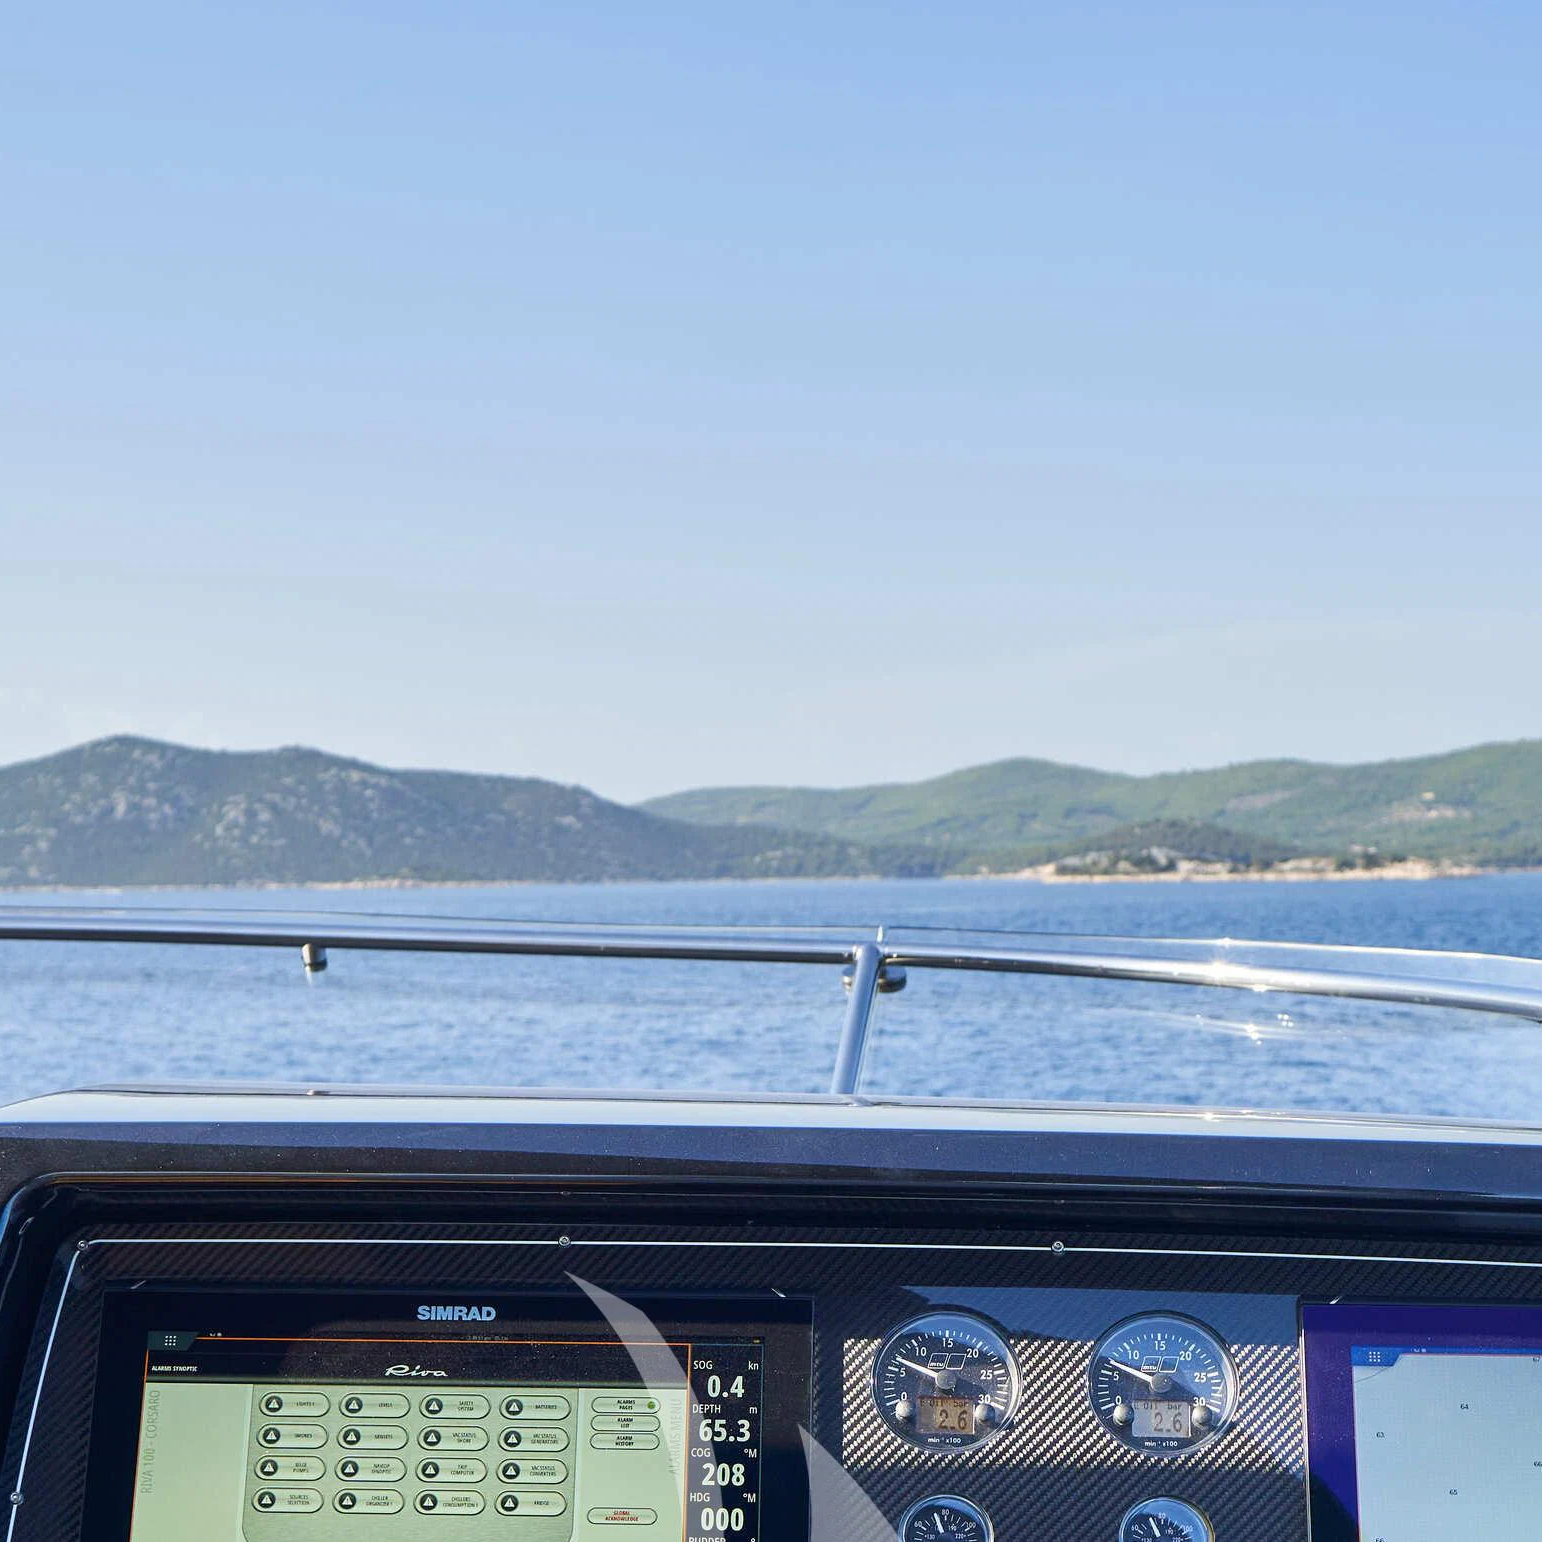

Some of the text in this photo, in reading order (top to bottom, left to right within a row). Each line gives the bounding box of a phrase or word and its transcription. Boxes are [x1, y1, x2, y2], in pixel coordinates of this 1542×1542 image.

[417, 1305, 496, 1321] SIMRAD
[942, 1338, 953, 1348] 15
[1154, 1340, 1166, 1351] 15
[915, 1347, 927, 1356] 10
[966, 1348, 979, 1358] 20
[1128, 1350, 1139, 1360] 10
[1179, 1351, 1192, 1361] 20
[693, 1360, 713, 1371] SOG
[748, 1360, 759, 1371] kn
[384, 1364, 449, 1378] Riva
[900, 1367, 906, 1377] 5
[980, 1370, 993, 1380] 25
[1113, 1371, 1119, 1381] 5
[1194, 1372, 1207, 1383] 25
[707, 1375, 745, 1398] 0.4
[901, 1392, 907, 1401] 0
[978, 1394, 991, 1404] 30
[1115, 1395, 1122, 1405] 0
[1193, 1397, 1206, 1406] 30
[692, 1404, 721, 1414] DEPTH
[749, 1406, 758, 1414] m
[145, 1390, 161, 1439] CORSARO
[939, 1409, 968, 1430] 2.6
[1153, 1412, 1182, 1433] 2.6
[699, 1419, 751, 1443] 65.3
[691, 1448, 711, 1458] COG
[702, 1463, 745, 1487] 208
[140, 1470, 153, 1494] RIVA
[689, 1492, 710, 1502] HDG
[700, 1507, 744, 1532] 000
[914, 1520, 923, 1528] 60
